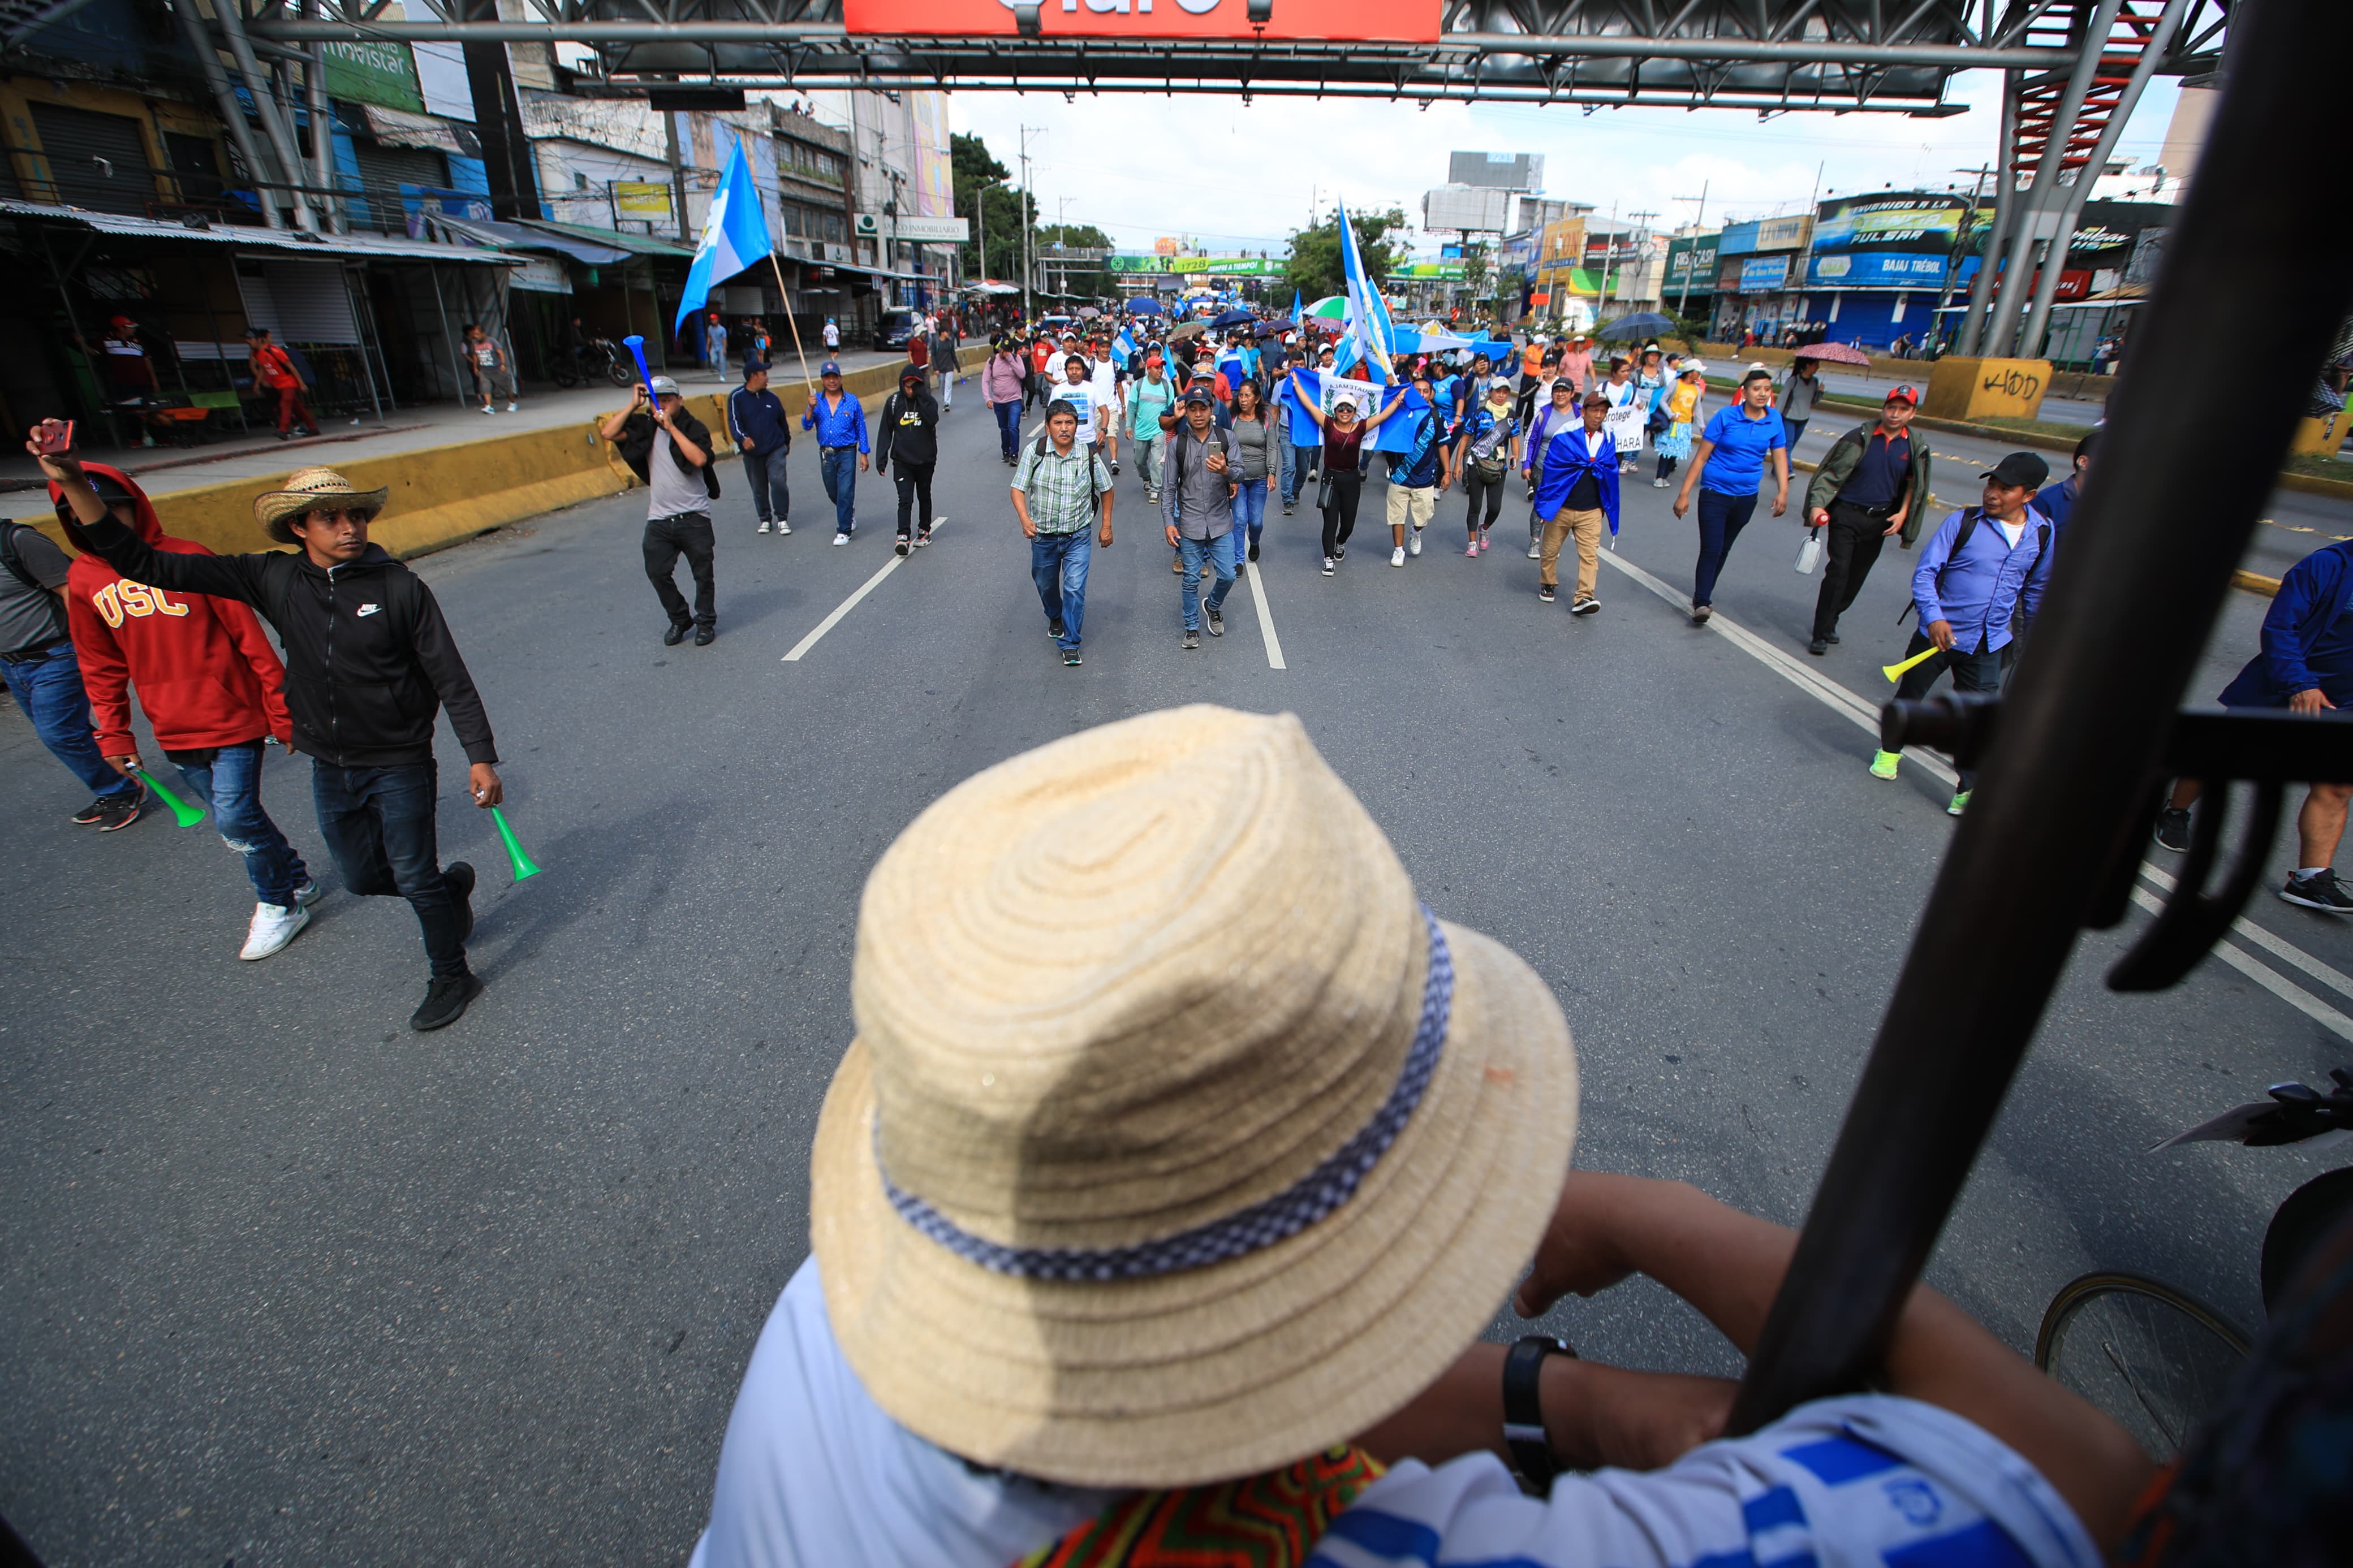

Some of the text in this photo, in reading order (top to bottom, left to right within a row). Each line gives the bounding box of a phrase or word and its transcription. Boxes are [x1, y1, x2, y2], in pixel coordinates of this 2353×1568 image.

[1850, 230, 1925, 245] PULSAR
[1181, 260, 1206, 270] 1728
[1233, 261, 1258, 271] TIEMPO!
[1673, 248, 1716, 271] FIRS CASH
[1882, 258, 1941, 274] BAJAJ TRÉBOL
[826, 330, 834, 339] 15
[92, 578, 191, 629] USC
